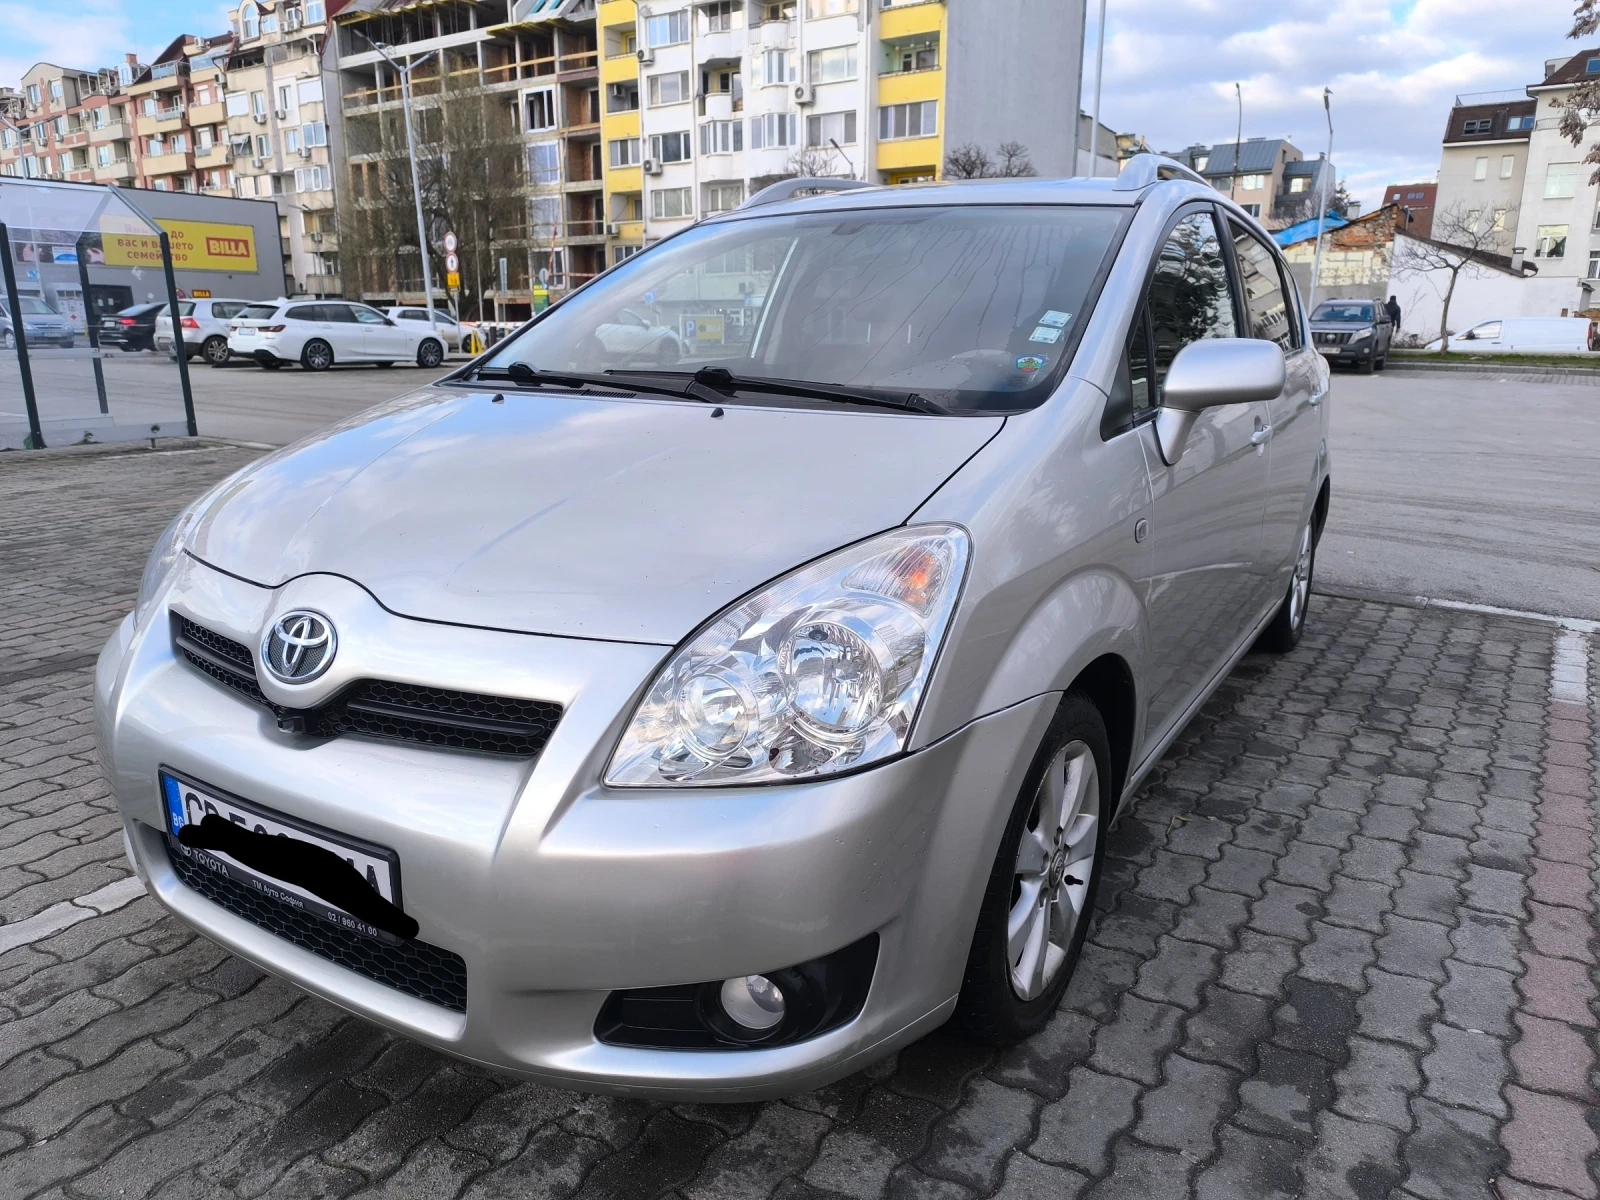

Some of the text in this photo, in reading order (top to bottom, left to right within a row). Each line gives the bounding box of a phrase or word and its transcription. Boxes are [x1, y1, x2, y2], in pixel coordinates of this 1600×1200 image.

[171, 230, 184, 240] до
[117, 238, 194, 251] вас и вшето
[209, 239, 248, 256] BILLA
[127, 249, 188, 262] семейво
[172, 811, 185, 828] BG
[193, 849, 229, 877] TOYOTA
[327, 911, 337, 922] 02
[357, 922, 366, 933] 41
[367, 926, 378, 937] 00
